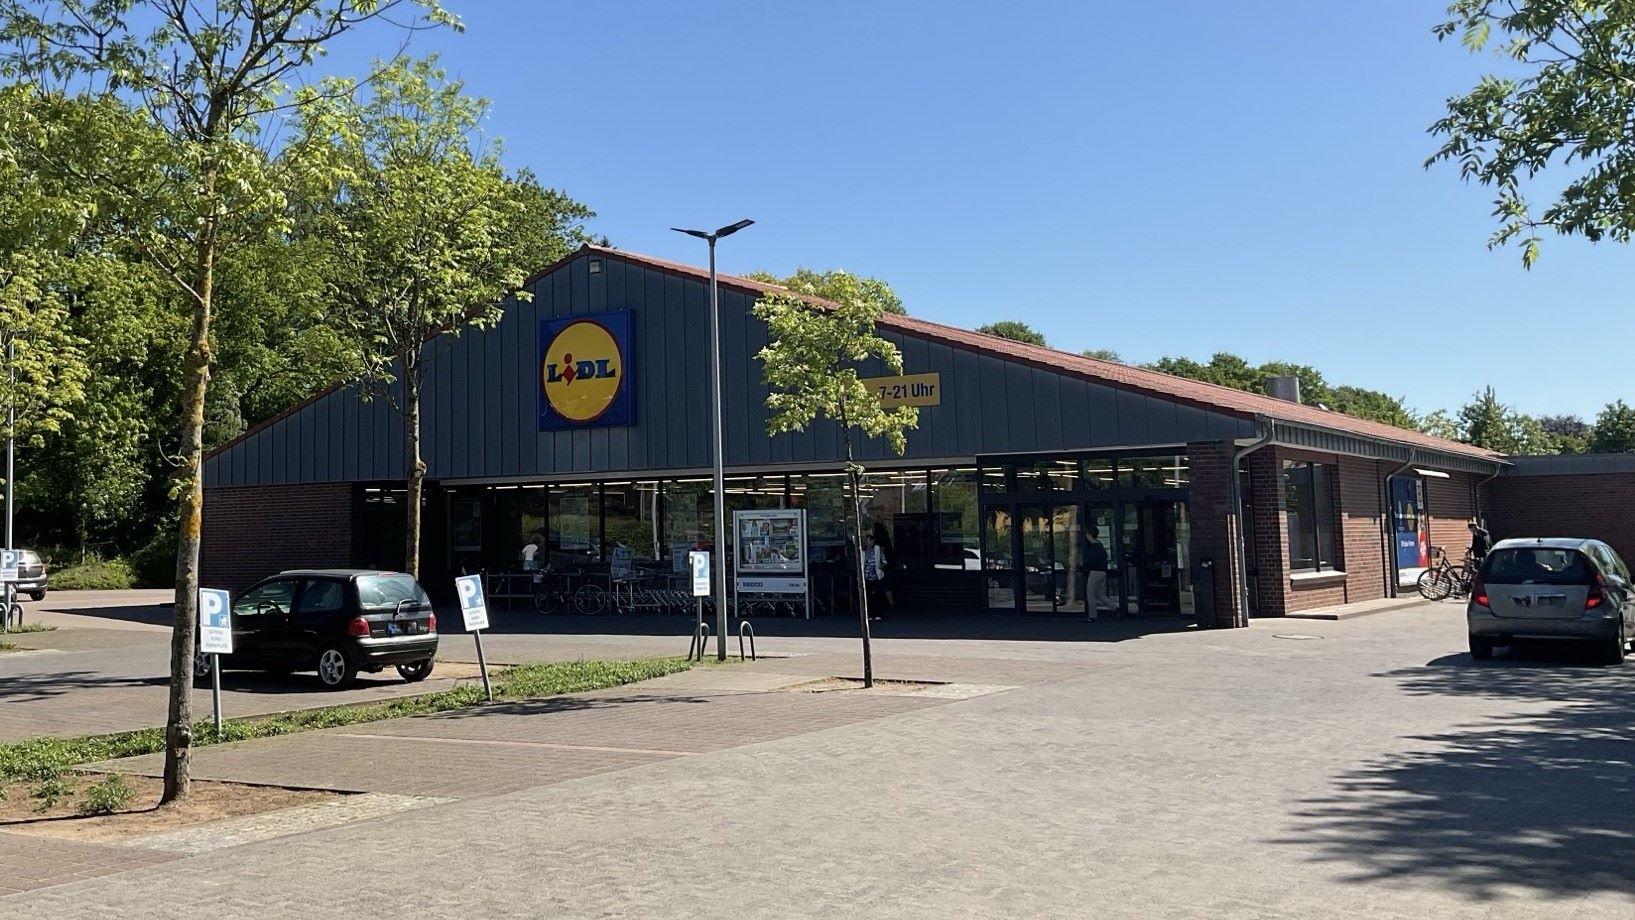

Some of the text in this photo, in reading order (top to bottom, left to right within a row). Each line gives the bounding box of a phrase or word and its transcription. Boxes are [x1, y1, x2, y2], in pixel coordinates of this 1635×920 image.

[879, 383, 935, 400] 7-21 Uhr
[2, 552, 14, 568] P
[693, 553, 705, 578] P
[458, 579, 477, 608] P
[202, 592, 222, 626] P
